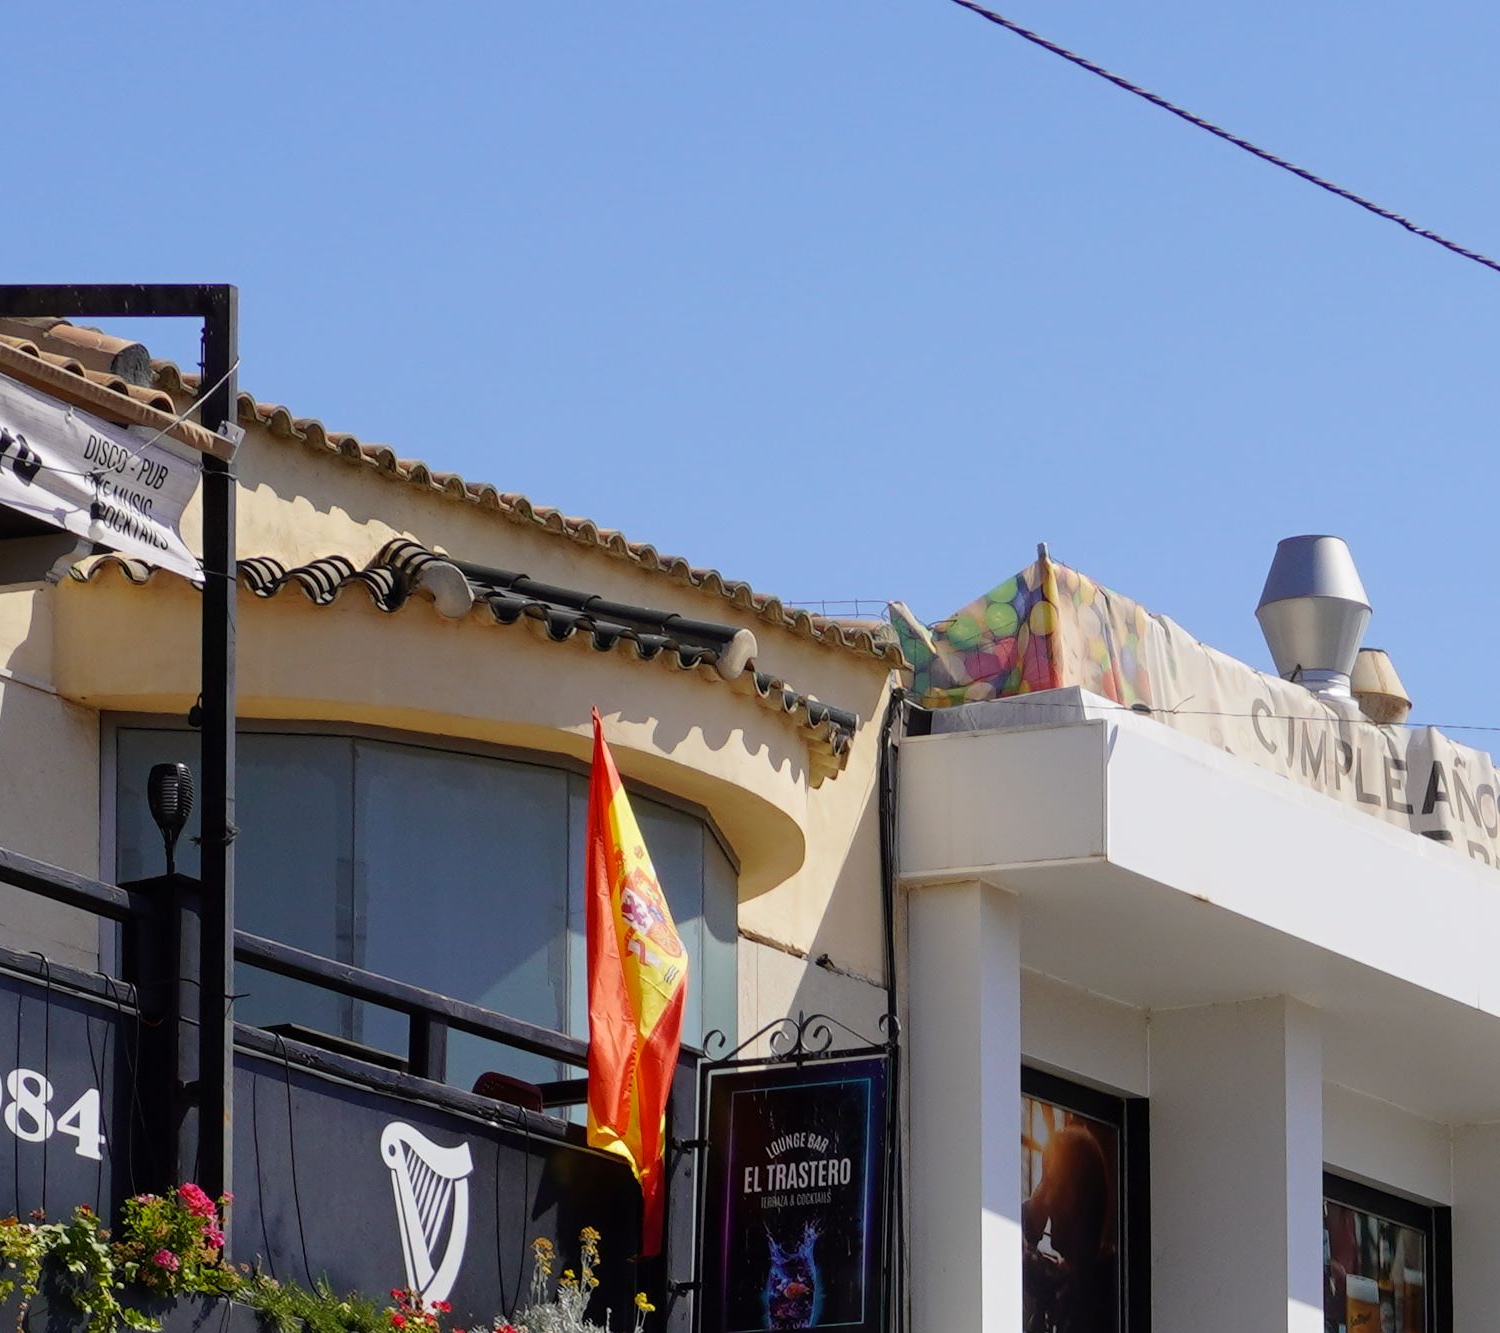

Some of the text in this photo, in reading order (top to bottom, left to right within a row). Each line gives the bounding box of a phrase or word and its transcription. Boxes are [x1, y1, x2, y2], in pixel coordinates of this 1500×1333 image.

[84, 434, 128, 474] DISCO
[135, 457, 169, 491] PUB
[765, 1132, 829, 1159] LOUNGE BAR
[744, 1158, 851, 1193] EL TRASTERO
[796, 1189, 833, 1206] COCKTAILS
